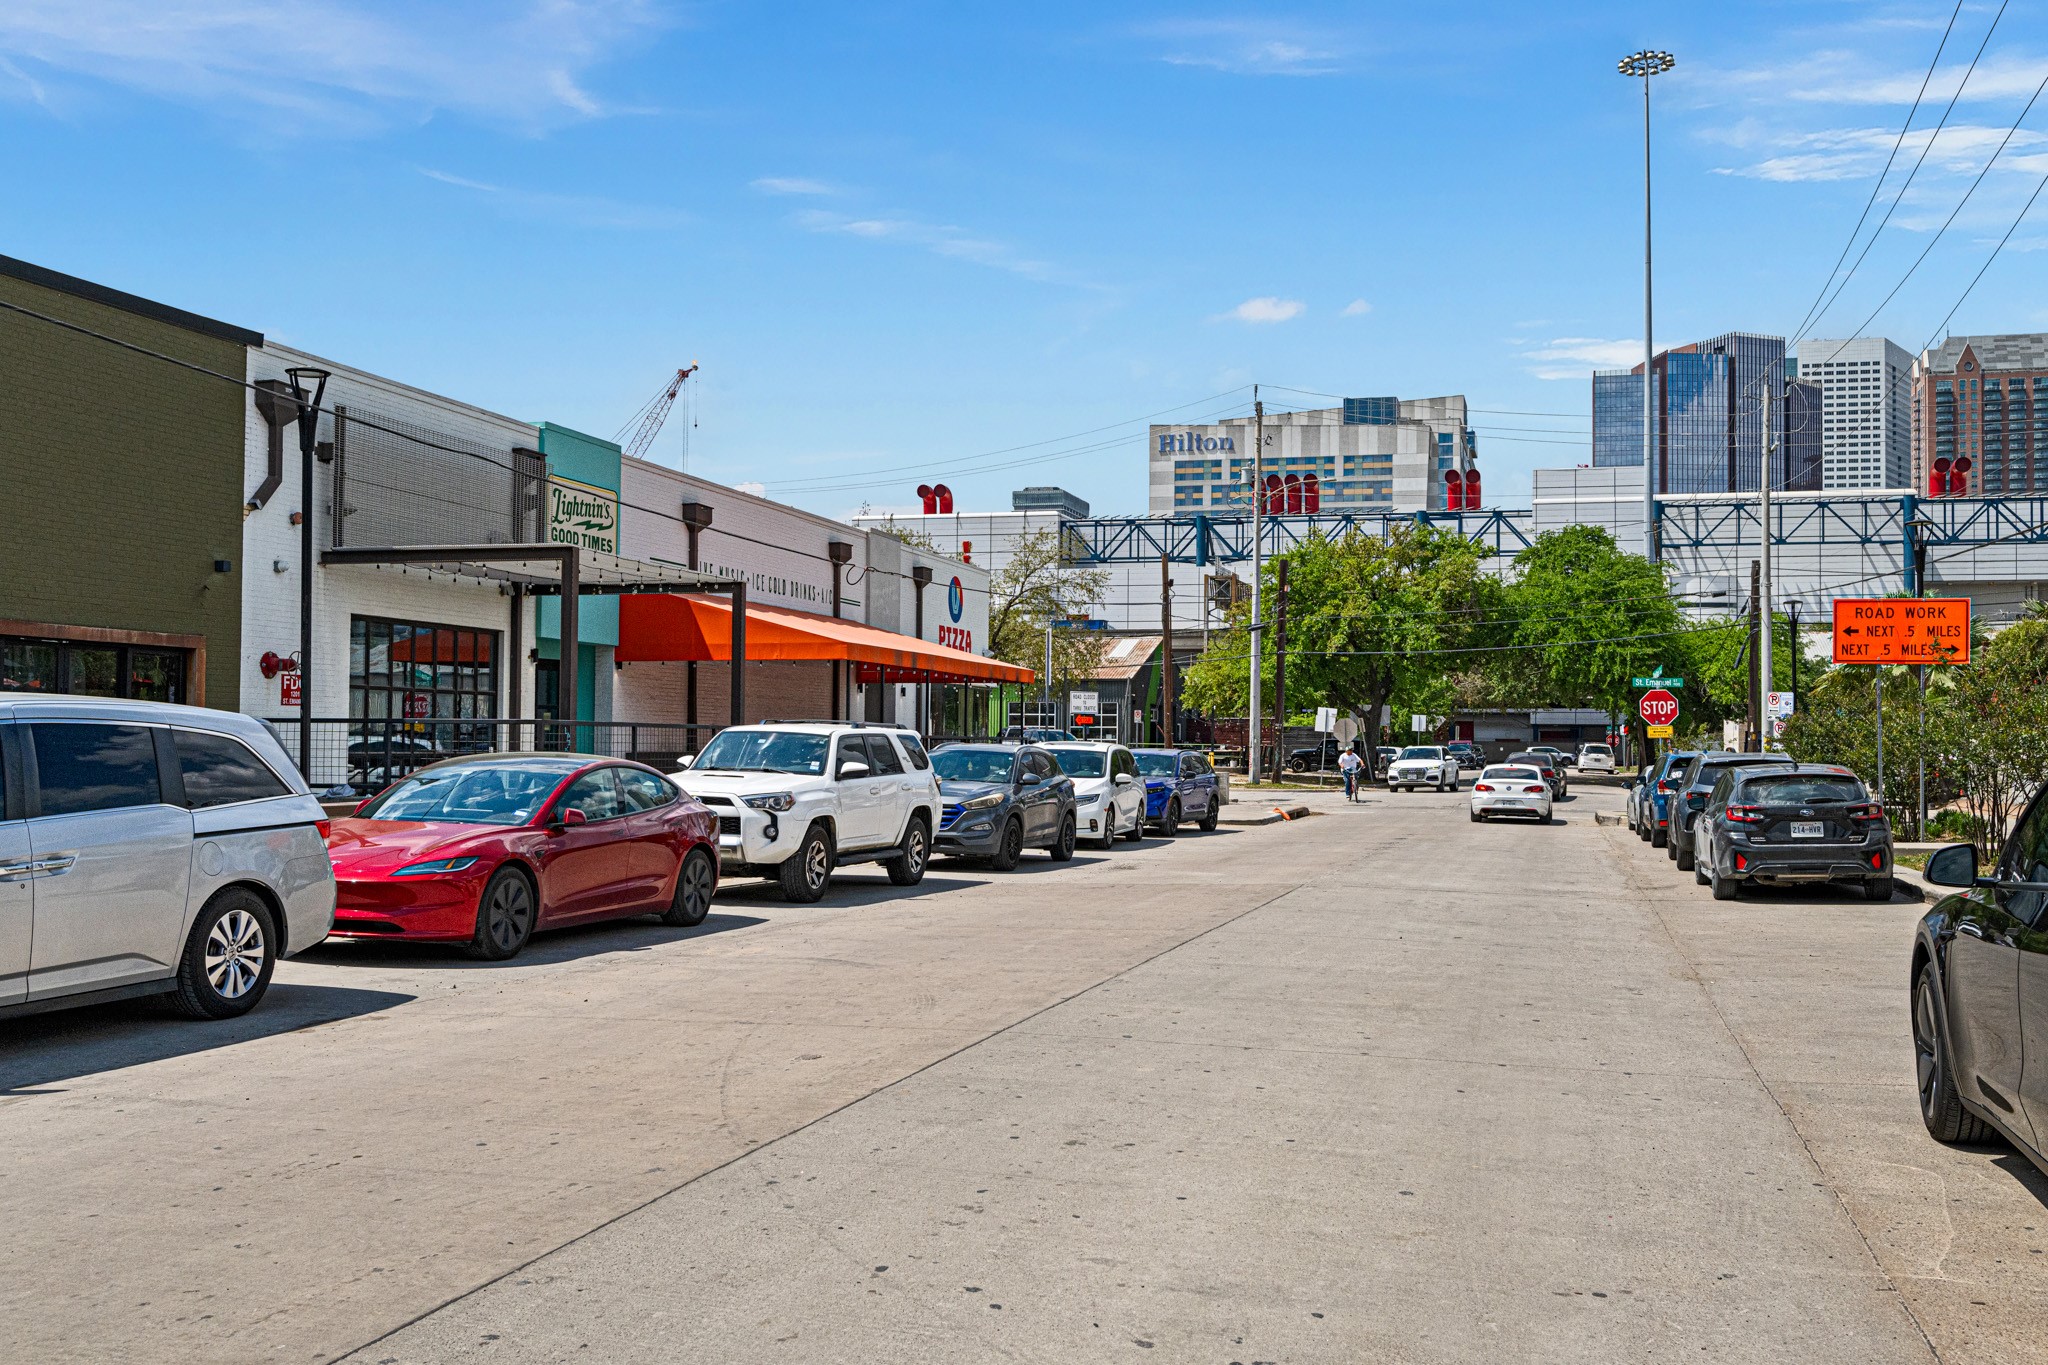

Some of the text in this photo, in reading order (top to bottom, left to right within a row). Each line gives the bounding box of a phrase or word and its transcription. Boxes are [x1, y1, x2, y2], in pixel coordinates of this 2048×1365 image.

[1159, 432, 1234, 452] Hilton
[552, 488, 610, 524] Lightnin's
[552, 527, 612, 553] GOOD TIMES
[700, 561, 713, 574] IVE
[752, 572, 764, 592] ICE
[769, 576, 786, 595] COLD
[791, 581, 815, 601] DRINKS
[1855, 607, 1946, 618] ROAD WORK
[939, 625, 972, 653] PIZZA
[1866, 626, 1960, 637] NEXT .5 MILES
[1842, 644, 1935, 655] NEXT .5 MILES
[1643, 701, 1675, 714] STOP
